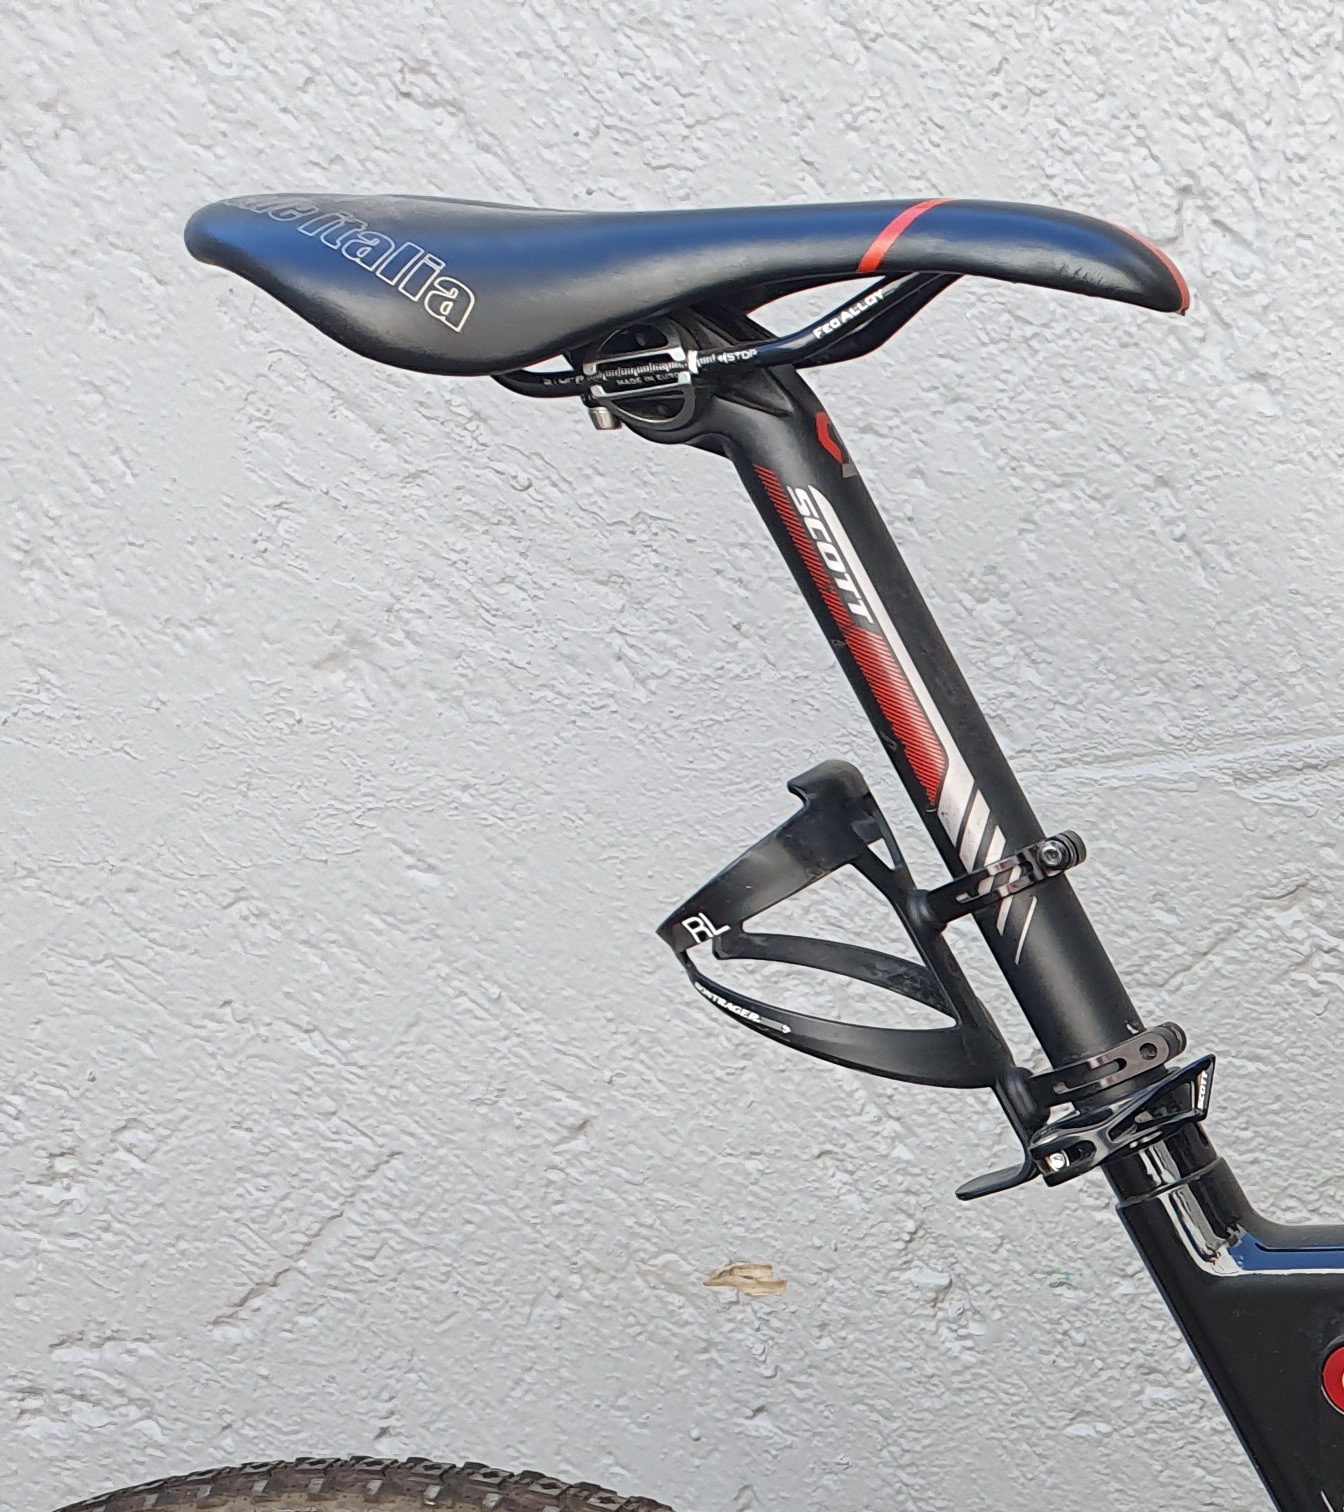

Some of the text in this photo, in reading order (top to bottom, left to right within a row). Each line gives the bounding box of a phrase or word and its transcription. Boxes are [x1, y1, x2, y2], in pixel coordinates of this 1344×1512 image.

[839, 288, 886, 324] ALLOY
[726, 349, 758, 362] STOP
[786, 485, 875, 625] SCOTT
[681, 912, 731, 944] RL
